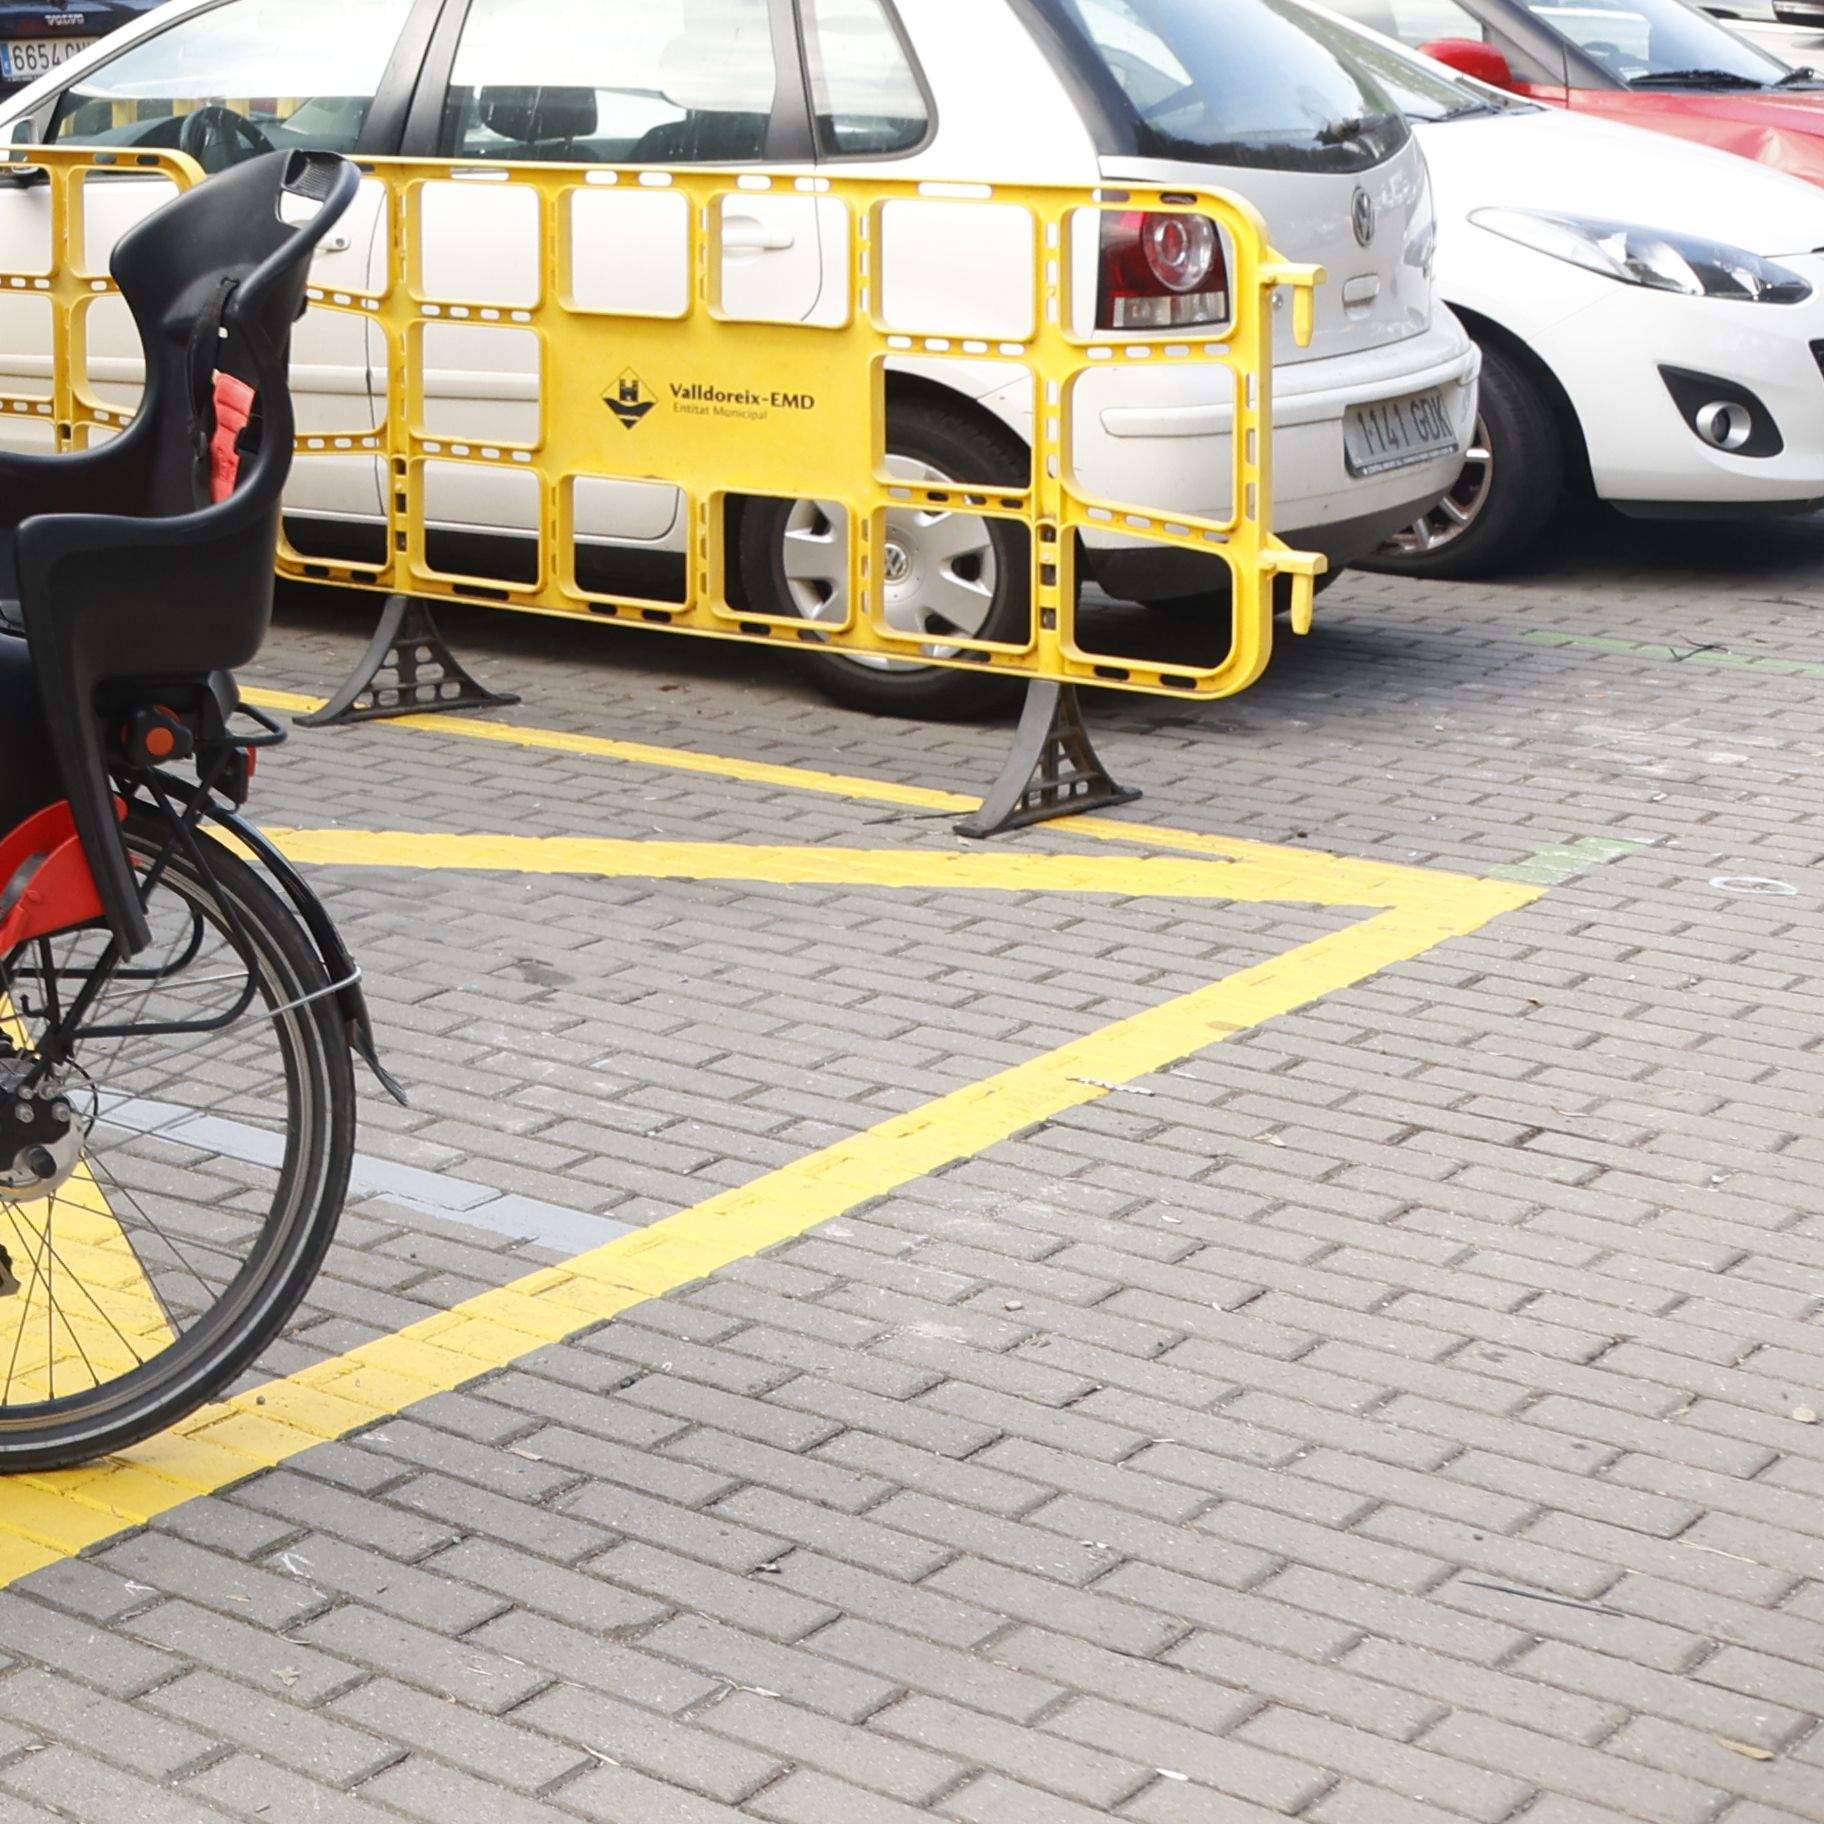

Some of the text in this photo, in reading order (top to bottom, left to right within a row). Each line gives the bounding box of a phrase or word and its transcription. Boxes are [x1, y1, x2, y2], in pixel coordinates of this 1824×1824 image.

[12, 43, 61, 71] 6654
[669, 383, 815, 410] Valldoreix-EMD
[673, 403, 768, 420] Entitat Municipal
[1357, 403, 1411, 456] 1141
